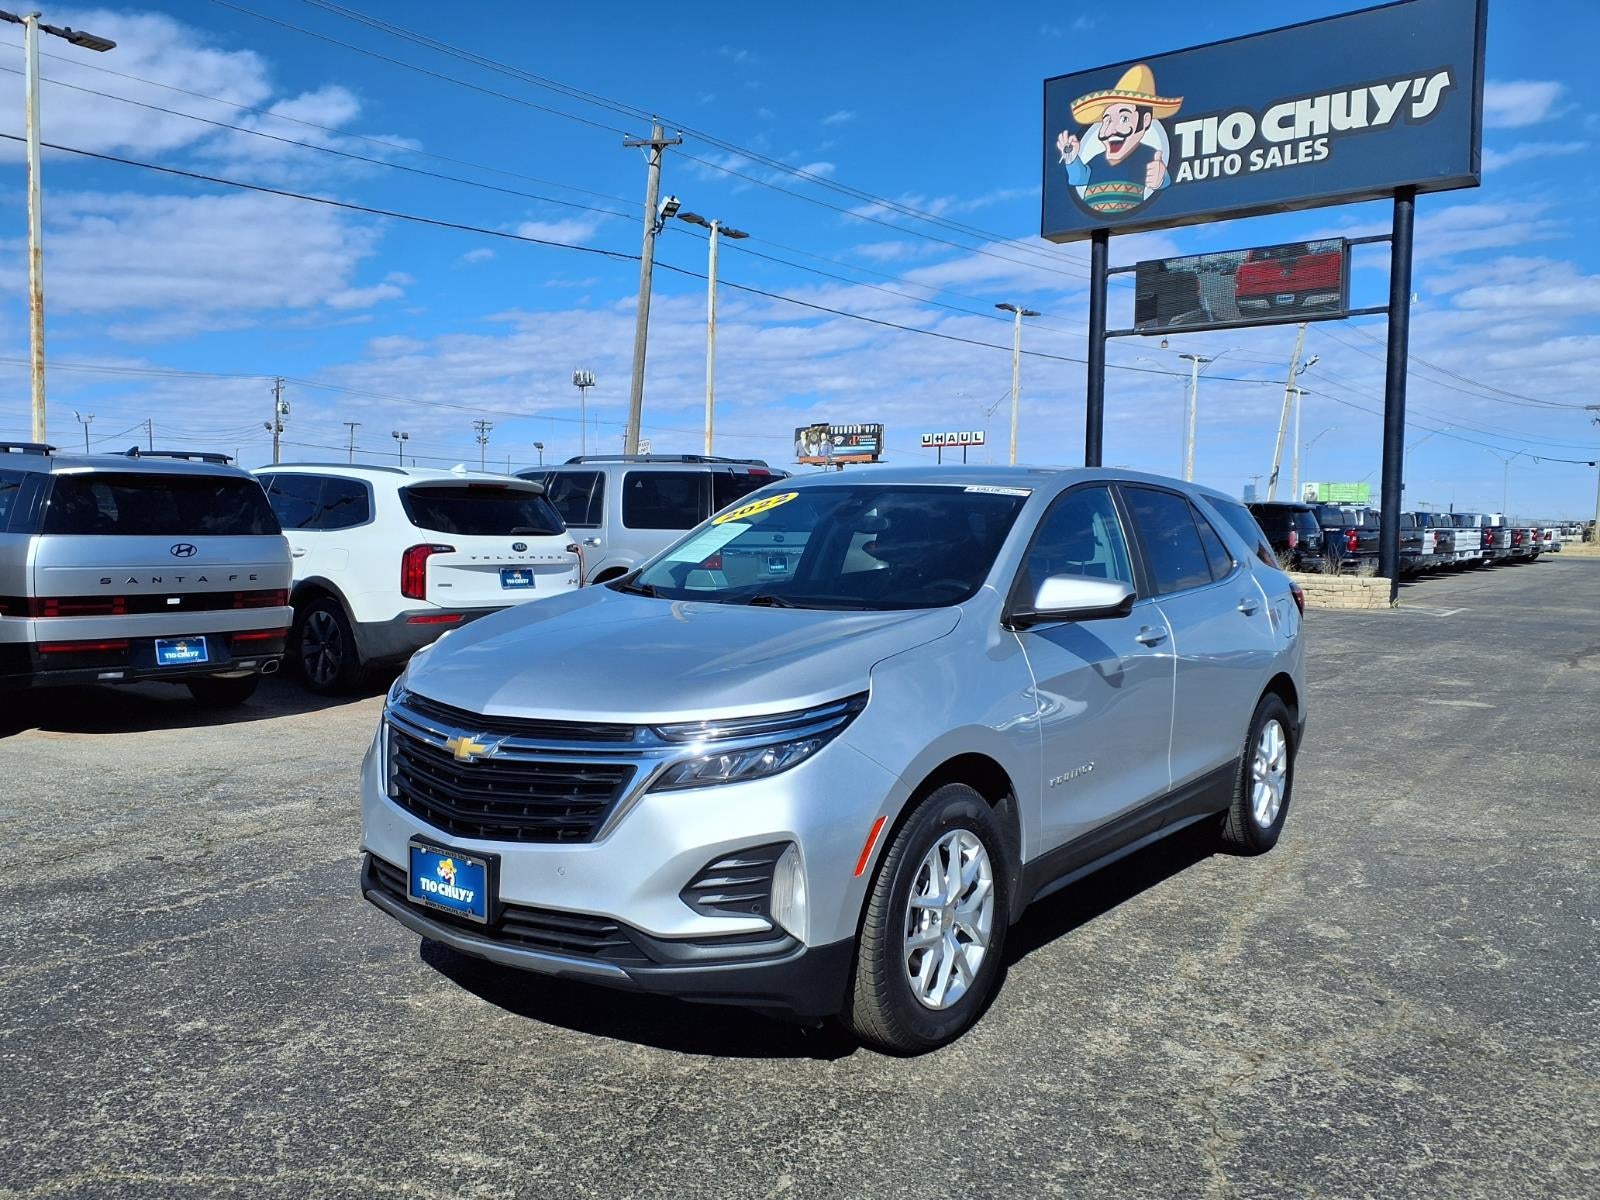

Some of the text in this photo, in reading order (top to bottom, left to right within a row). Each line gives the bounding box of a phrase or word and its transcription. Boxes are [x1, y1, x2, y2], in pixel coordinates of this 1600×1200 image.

[1174, 71, 1450, 158] TIO CHUY'S
[1175, 138, 1329, 183] AUTO SALES
[722, 494, 790, 520] 2022
[99, 574, 257, 585] SANTA FE
[420, 877, 474, 903] TIO CHUY'S
